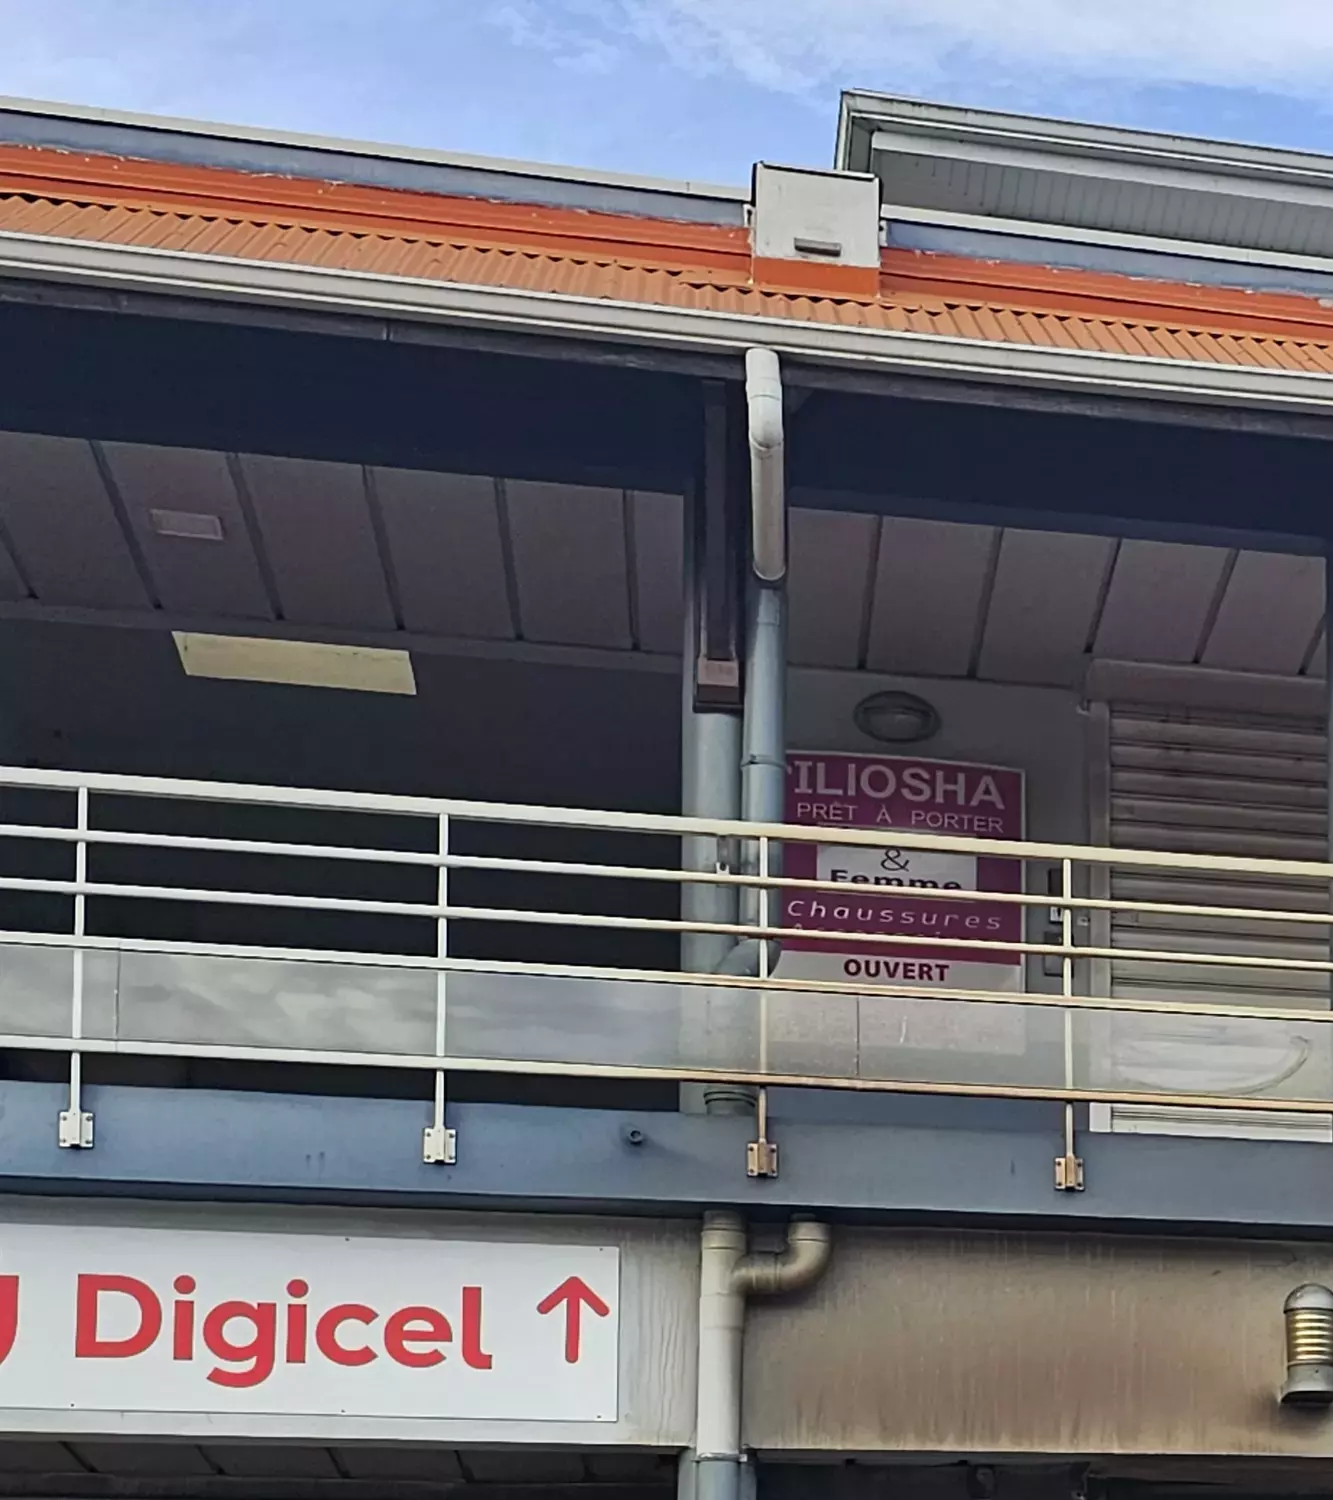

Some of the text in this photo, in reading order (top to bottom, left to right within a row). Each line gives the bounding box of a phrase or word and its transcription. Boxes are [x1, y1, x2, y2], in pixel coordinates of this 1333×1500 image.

[794, 760, 1006, 810] ILIOSHA
[797, 801, 1004, 833] PRÊT À PORTER
[787, 900, 1002, 930] Chaussures
[844, 958, 950, 982] OUVERT
[75, 1273, 494, 1389] Digicel
